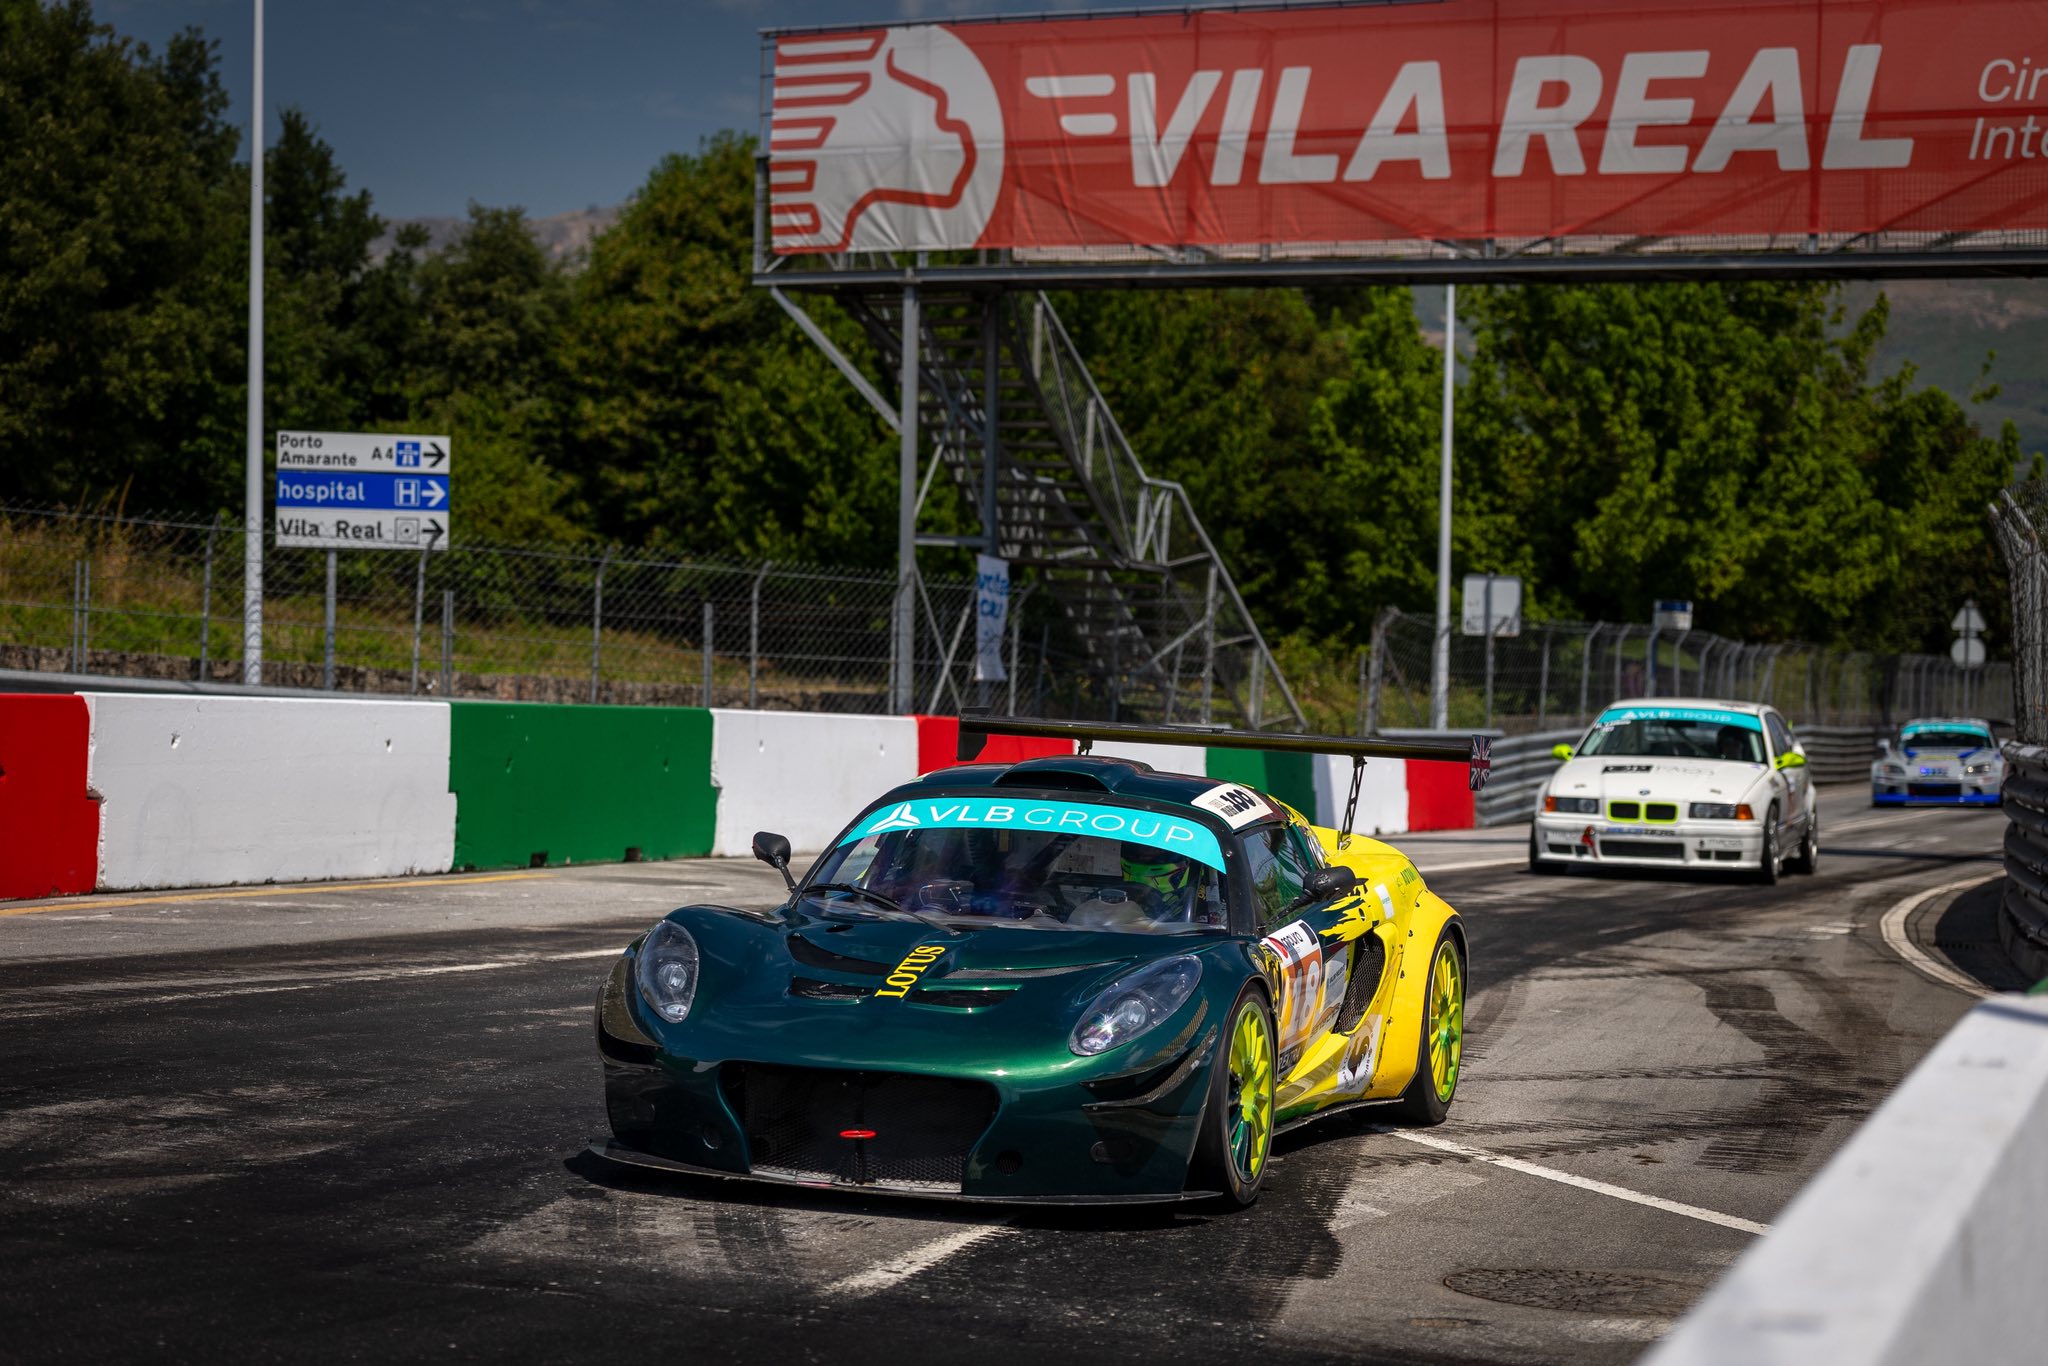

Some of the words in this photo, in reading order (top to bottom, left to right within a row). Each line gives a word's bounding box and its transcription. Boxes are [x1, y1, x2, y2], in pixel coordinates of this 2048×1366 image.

[1128, 61, 1451, 187] VILA
[1492, 44, 1914, 177] REAL
[280, 434, 323, 448] Porto
[280, 451, 357, 466] Amarante
[278, 480, 365, 503] hospital
[280, 518, 319, 537] Vila
[336, 520, 383, 539] Real
[929, 804, 1015, 823] VLB
[1023, 808, 1195, 843] GROUP
[873, 945, 944, 999] LOTUS
